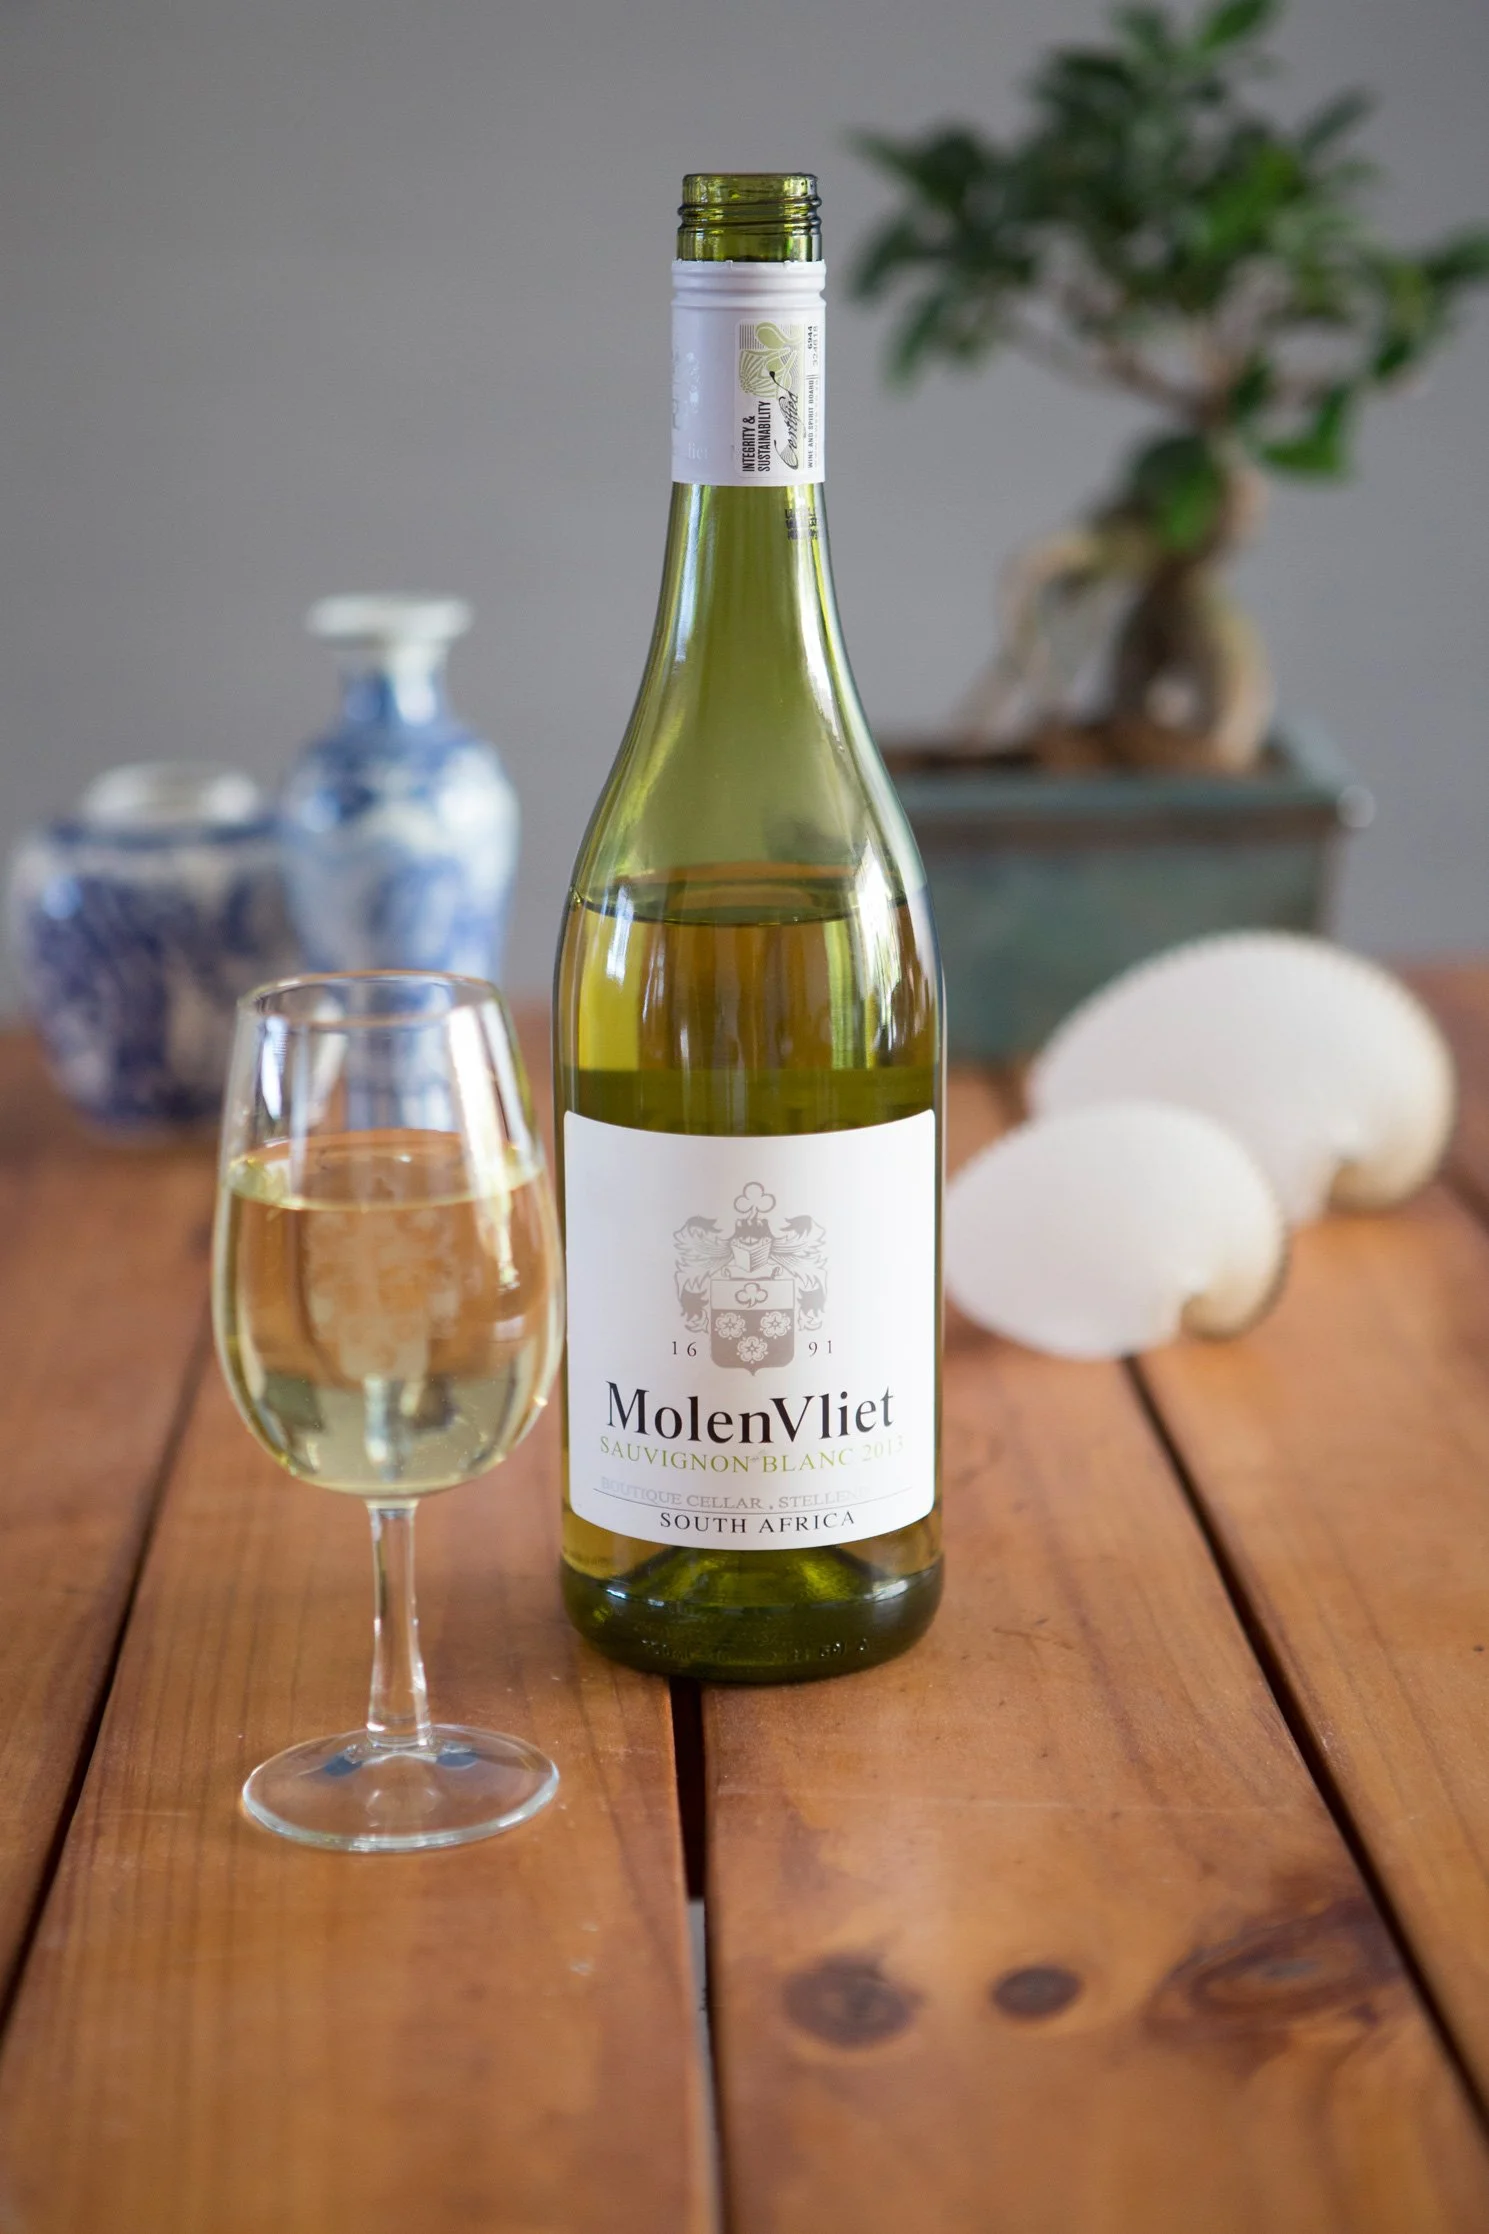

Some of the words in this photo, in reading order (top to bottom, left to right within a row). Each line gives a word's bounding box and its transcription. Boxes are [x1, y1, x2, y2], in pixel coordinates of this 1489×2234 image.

[741, 415, 756, 425] &
[757, 400, 771, 473] SUSTAINABILITY
[741, 426, 756, 473] INTEGRITY
[605, 1380, 895, 1445] MolenVliet
[600, 1435, 750, 1474] SAUVIGNON
[762, 1448, 854, 1474] BLANC
[862, 1432, 904, 1461] 2013
[600, 1476, 682, 1507] BOUTIQUE
[659, 1511, 747, 1534] SOUTH
[758, 1510, 856, 1534] AFRICA
